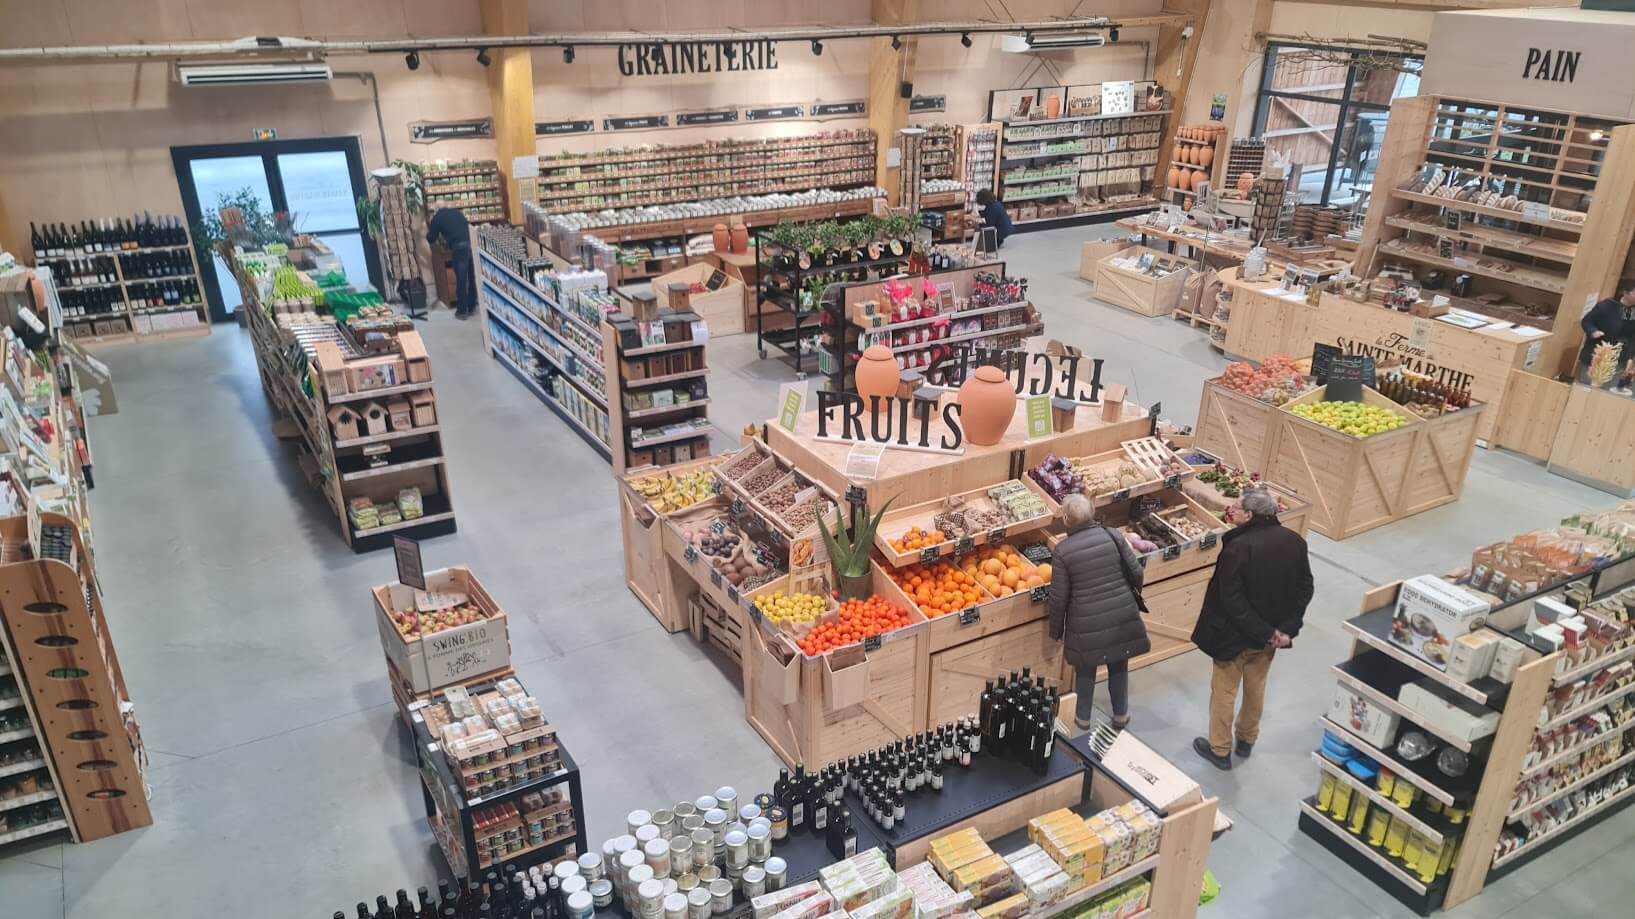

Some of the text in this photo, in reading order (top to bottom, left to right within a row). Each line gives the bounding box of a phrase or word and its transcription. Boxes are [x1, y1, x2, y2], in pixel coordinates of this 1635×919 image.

[618, 40, 778, 76] GRAINETERIE
[1522, 47, 1582, 83] PAIN
[815, 390, 963, 450] FRUITS
[433, 626, 487, 652] SWING BIO
